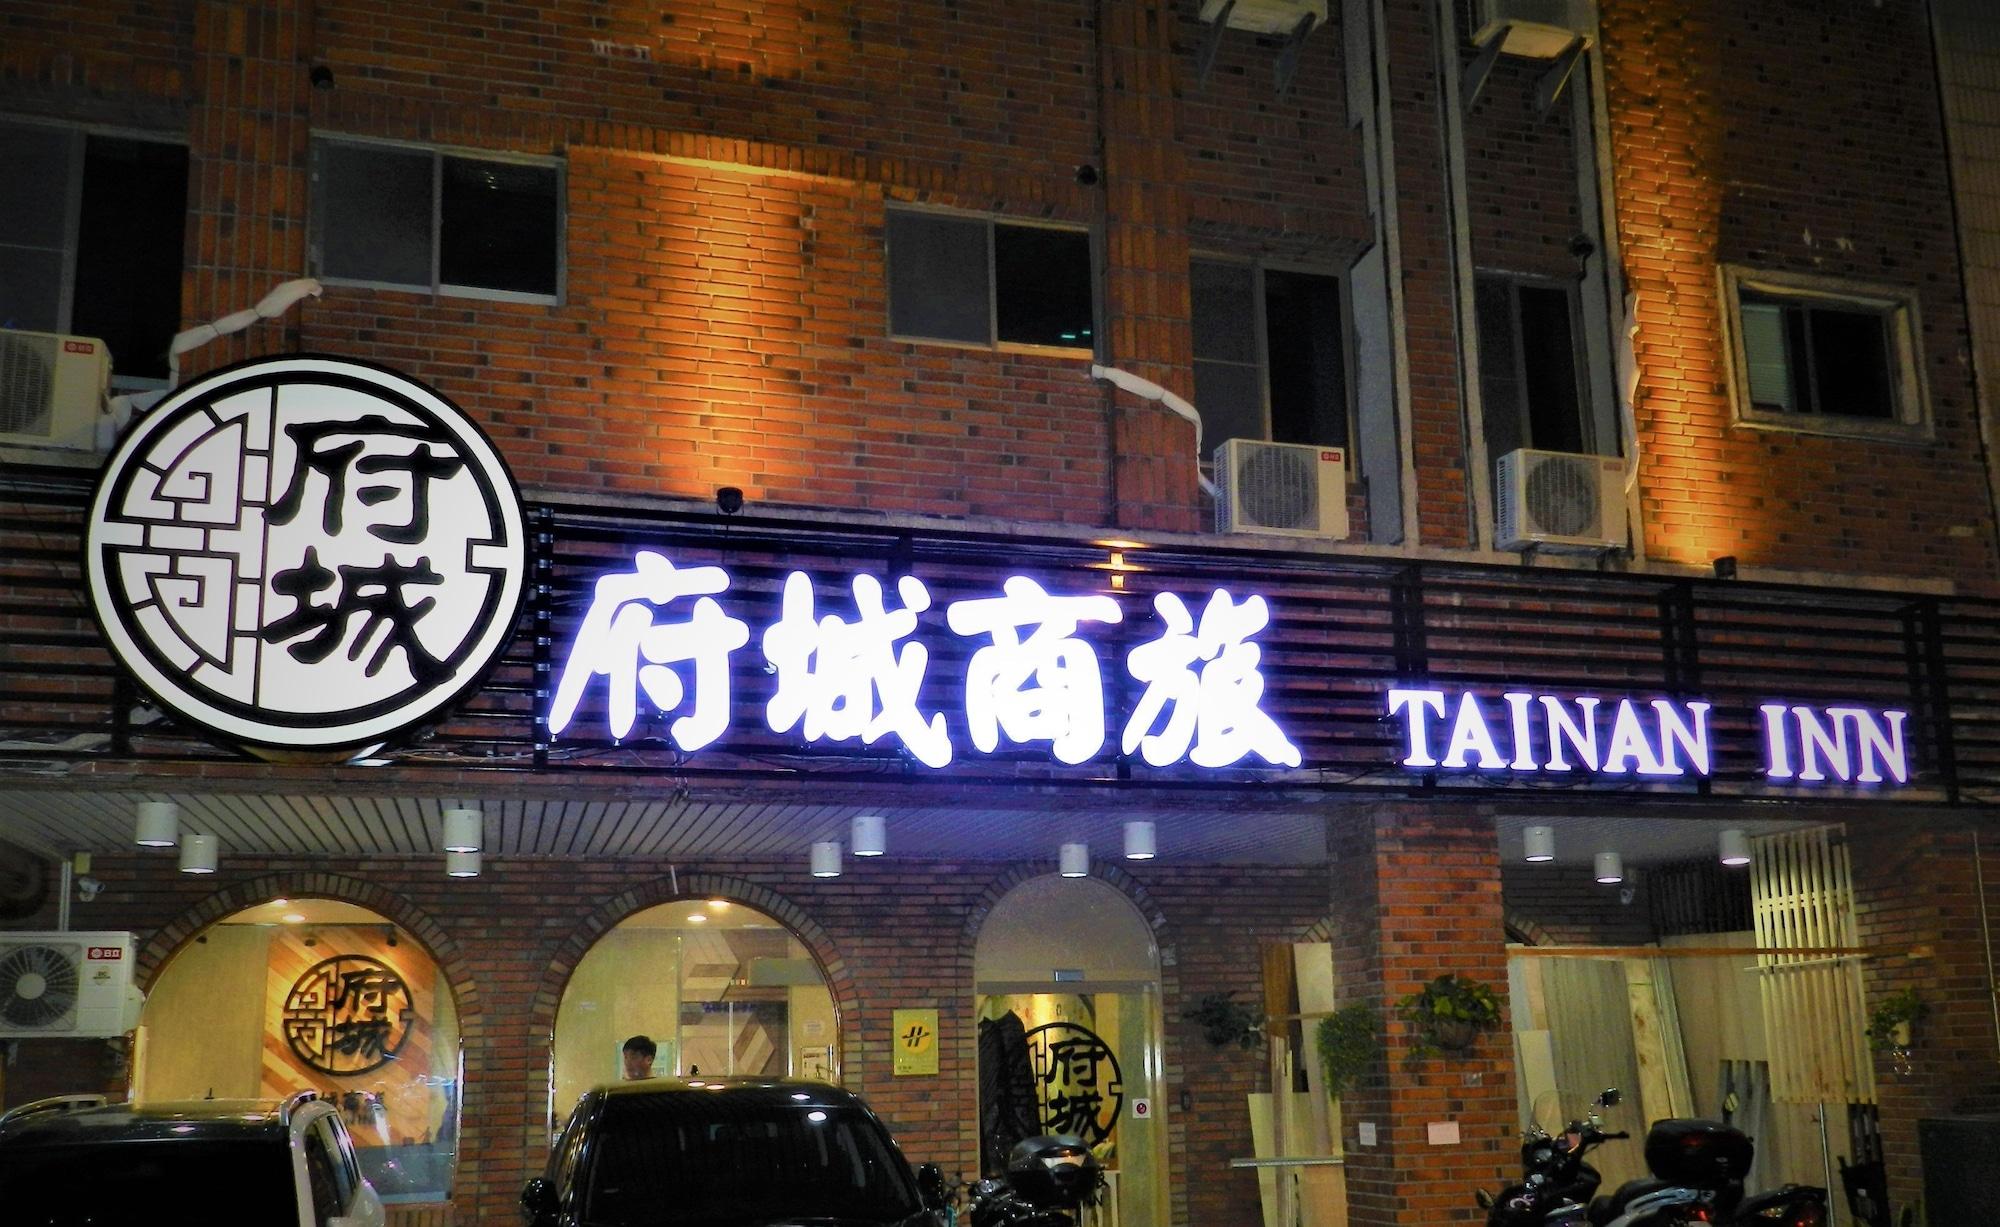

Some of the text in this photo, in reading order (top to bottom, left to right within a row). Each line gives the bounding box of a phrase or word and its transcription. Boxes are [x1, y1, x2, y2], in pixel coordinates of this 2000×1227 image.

[263, 414, 463, 687] 府城
[548, 550, 1303, 768] 府城商旅
[1388, 689, 1907, 784] TAINAN INN
